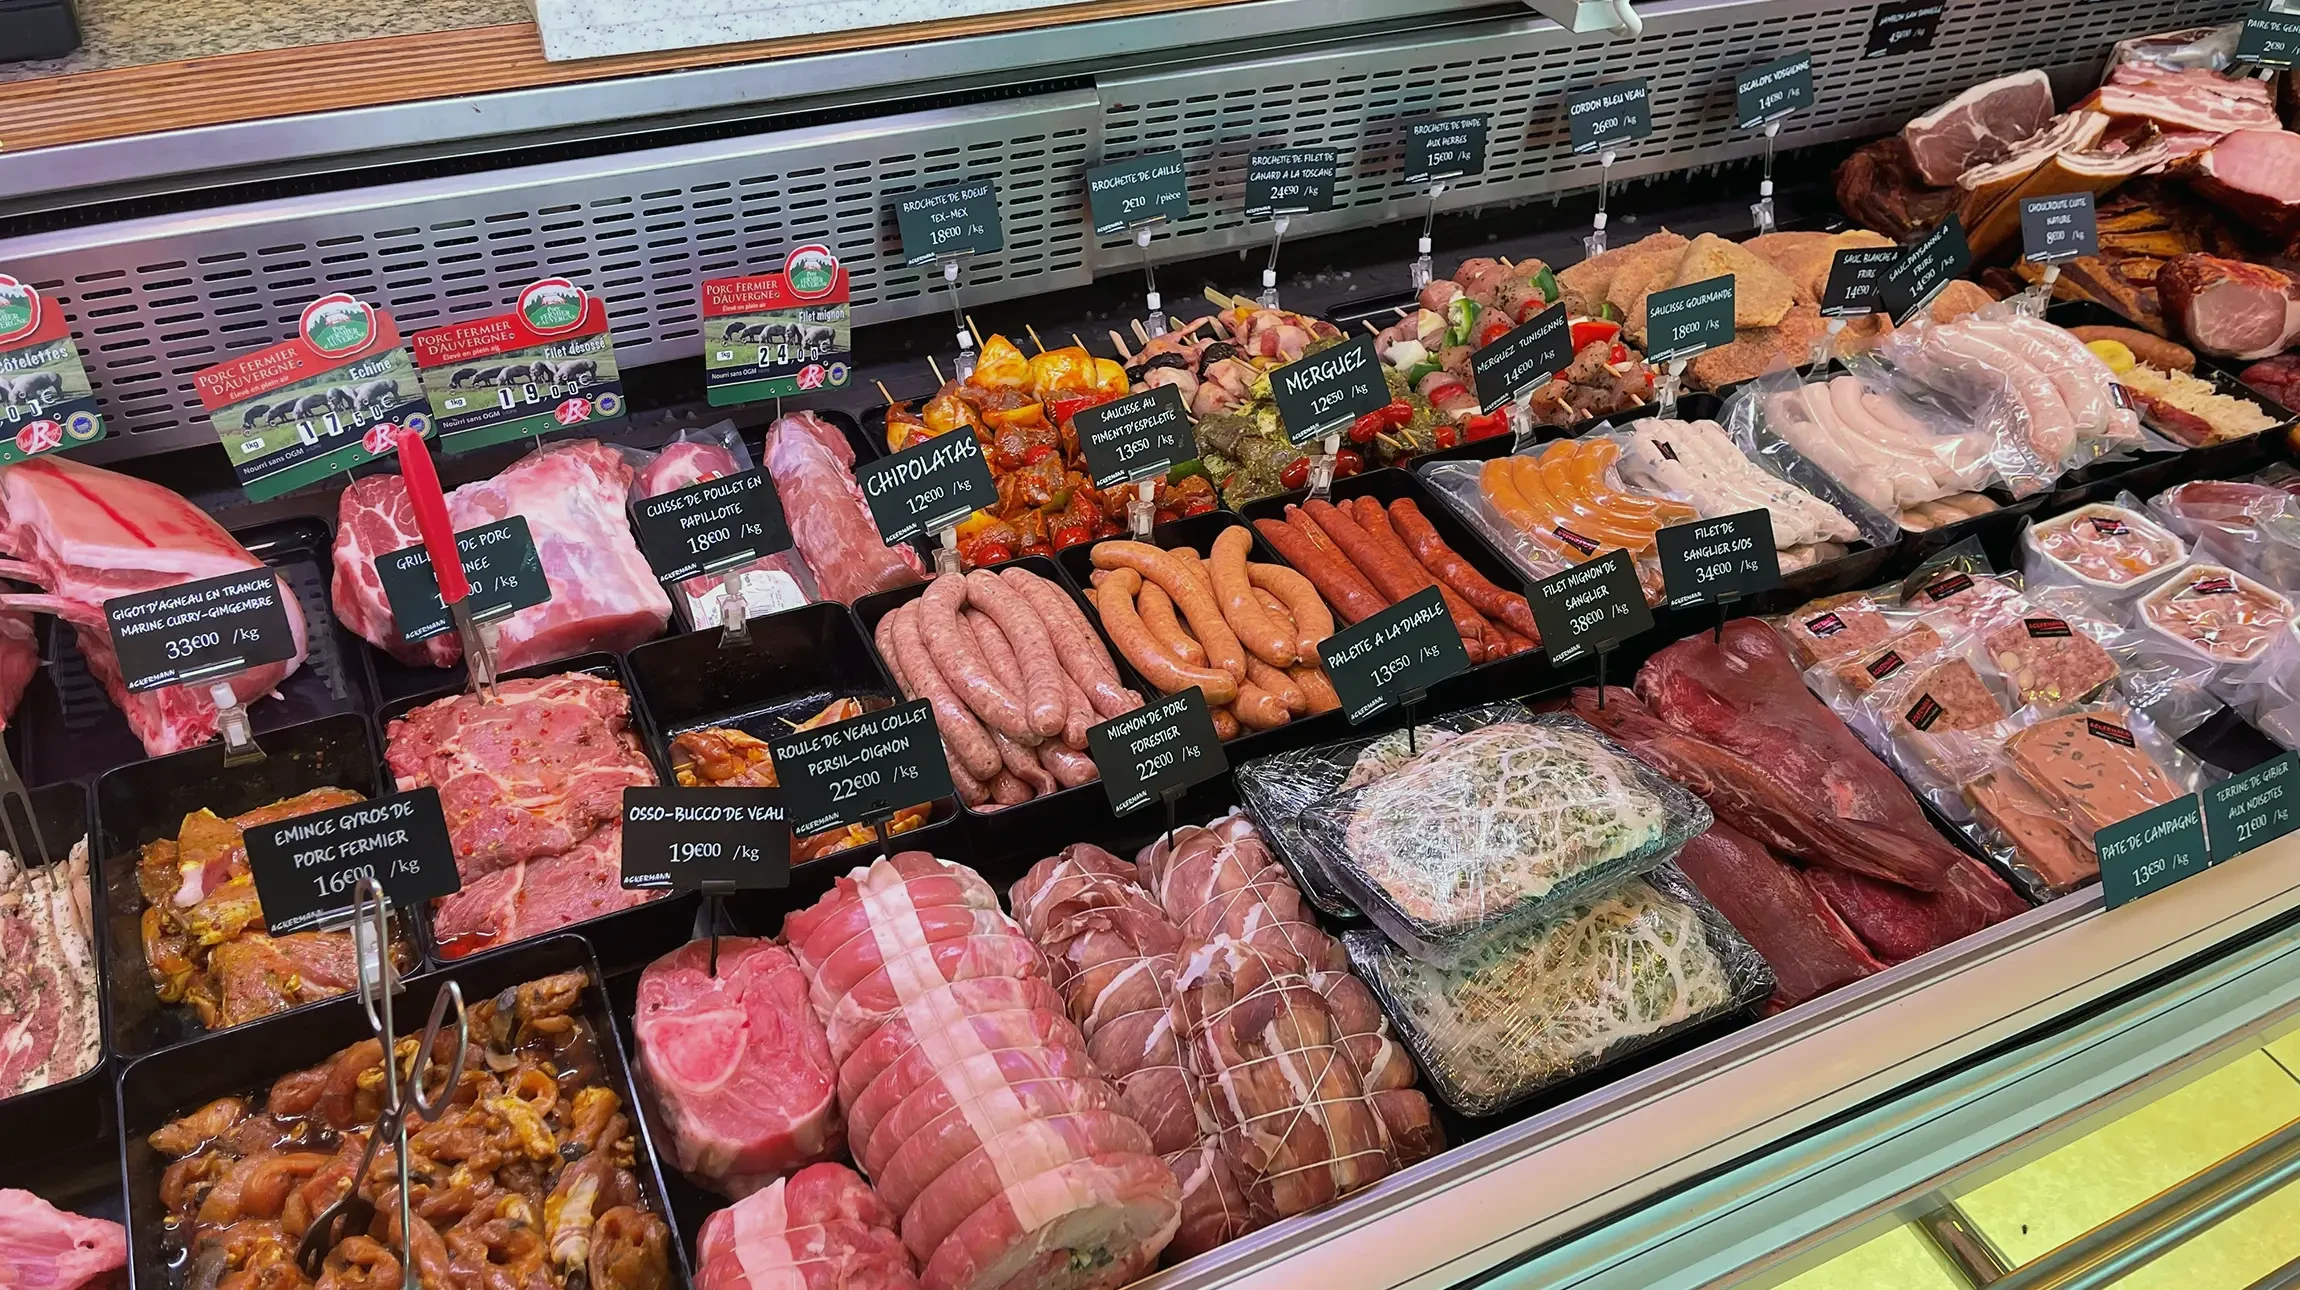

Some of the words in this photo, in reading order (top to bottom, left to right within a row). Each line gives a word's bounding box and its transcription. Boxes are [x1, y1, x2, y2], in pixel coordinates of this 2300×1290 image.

[2247, 19, 2269, 30] PAIRE
[2271, 22, 2281, 31] DE
[1571, 99, 1601, 115] CORDON
[1603, 93, 1623, 107] BLEU
[1625, 88, 1645, 100] VEAU
[1414, 122, 1449, 135] BROCHETTE
[1450, 120, 1460, 130] DE
[1461, 118, 1481, 129] DINDE
[1592, 117, 1618, 135] 26€00
[1623, 116, 1636, 126] /kg
[1252, 155, 1291, 166] BROCHETTE
[1292, 154, 1303, 164] DE
[1304, 153, 1323, 163] FILET
[1324, 152, 1334, 161] DE
[1428, 151, 1453, 166] 15€00
[1457, 151, 1471, 161] /kg
[1092, 173, 1137, 192] BROCHETTE
[1137, 170, 1150, 181] DE
[1151, 163, 1182, 179] CAILLE
[1250, 171, 1281, 181] CANARD
[1282, 171, 1288, 179] A
[1290, 169, 1300, 178] LA
[1302, 168, 1333, 178] TOSCANE
[903, 194, 947, 213] BROCHETTE
[947, 192, 960, 203] DE
[961, 185, 989, 201] BOEUF
[1122, 196, 1146, 213] 2€10
[1270, 185, 1299, 199] 24€90
[1303, 185, 1319, 196] /kg
[931, 207, 968, 223] TEX-MEX
[930, 225, 961, 245] 18€00
[967, 224, 984, 236] /kg
[1909, 268, 1936, 298] 14€90
[1940, 255, 1955, 271] /kg
[1913, 254, 1934, 276] FRIRE
[707, 285, 733, 295] PORC
[736, 280, 778, 291] FERMIER
[1845, 285, 1869, 299] 14€90
[799, 310, 815, 322] Filet
[816, 309, 845, 322] mignon
[1650, 300, 1684, 318] SAUCISSE
[1686, 288, 1732, 309] GOURMANDE
[418, 332, 452, 347] PORC
[456, 321, 511, 339] FERMIER
[1672, 321, 1700, 340] 18€00
[1705, 319, 1720, 331] /kg
[442, 351, 461, 361] Élevé
[472, 347, 490, 357] plein
[545, 345, 567, 359] Filet
[569, 337, 606, 355] désossé
[1477, 345, 1515, 374] MERGUEZ
[1519, 316, 1564, 348] TUNISIENNE
[198, 367, 236, 388] PORC
[240, 347, 298, 372] FERMIER
[349, 358, 392, 380] Echine
[1285, 347, 1366, 395] MERGUEZ
[1504, 359, 1533, 385] 14€00
[1540, 350, 1555, 364] /kg
[229, 388, 249, 400] Élevé
[250, 386, 260, 394] en
[261, 378, 280, 391] plein
[281, 375, 290, 385] air
[1311, 390, 1344, 415] 12€50
[1351, 383, 1368, 398] /kg
[443, 418, 466, 429] Nourri
[466, 415, 482, 424] sans
[483, 410, 500, 420] OGM
[1101, 401, 1141, 422] SAUCISSE
[1142, 397, 1156, 409] AU
[244, 439, 260, 450] 1kg
[1092, 425, 1124, 444] PIMENT
[1116, 438, 1150, 461] 13€50
[1157, 434, 1174, 448] /kg
[243, 461, 268, 475] Nourri
[268, 454, 285, 467] sans
[285, 447, 304, 460] OGM
[867, 436, 977, 496] CHIPOLATAS
[647, 498, 684, 517] CUISSE
[684, 493, 702, 507] DE
[703, 480, 744, 501] POULET
[746, 475, 762, 489] EN
[906, 486, 944, 514] 12€00
[953, 480, 972, 495] /kg
[680, 502, 743, 529] PAPILLOTTE
[457, 539, 478, 552] DE
[479, 527, 512, 546] PORC
[687, 527, 730, 554] 18€00
[741, 522, 762, 539] /kg
[1694, 524, 1721, 540] FILET
[1720, 521, 1735, 535] DE
[1683, 541, 1731, 562] SANGLIER
[1731, 537, 1753, 552] S/OS
[494, 574, 518, 592] /kg
[1542, 579, 1567, 598] FILET
[1568, 565, 1603, 588] MIGNON
[1602, 560, 1617, 574] DE
[1695, 561, 1732, 583] 34€00
[1740, 559, 1758, 573] /kg
[112, 605, 147, 621] GIGOT
[146, 593, 203, 615] D'AGNEAU
[206, 589, 220, 600] EN
[222, 578, 273, 598] TRANCHE
[1565, 585, 1610, 611] SANGLIER
[120, 618, 164, 637] MARINE
[166, 595, 274, 629] CURRY-GIMGEMBRE
[1570, 608, 1604, 636] 38€00
[1611, 603, 1629, 619] /kg
[165, 631, 219, 660] 33€00
[232, 627, 260, 644] /kg
[1327, 638, 1373, 669] PALETTE
[1374, 632, 1384, 647] A
[1385, 624, 1401, 641] LA
[1400, 602, 1444, 633] DIABLE
[128, 669, 176, 689] ACKERMANN
[1371, 654, 1411, 688] 13€50
[1419, 644, 1440, 664] /kg
[1106, 716, 1147, 741] MIGNON
[1146, 709, 1163, 725] DE
[1162, 698, 1188, 718] PORC
[777, 738, 822, 761] ROULE
[820, 732, 842, 748] DE
[842, 722, 879, 741] VEAU
[881, 707, 928, 732] COLLET
[1130, 725, 1181, 756] FORESTIER
[808, 736, 910, 777] PERSIL-OIGNON
[1135, 751, 1174, 782] 22€00
[1182, 745, 1201, 762] /kg
[829, 770, 881, 802] 22€00
[893, 764, 919, 783] /kg
[2216, 781, 2251, 802] TERRINE
[2249, 773, 2262, 789] DE
[2262, 761, 2289, 782] GIBIER
[629, 806, 722, 822] OSSO-BUCCO
[722, 806, 744, 821] DE
[747, 806, 784, 822] VEAU
[2228, 804, 2246, 820] AUX
[2247, 784, 2284, 810] NOISETTES
[275, 818, 336, 846] EMINCE
[339, 807, 390, 831] GYROS
[388, 800, 414, 818] DE
[795, 811, 840, 835] ACKERMANN
[2101, 838, 2128, 861] PATE
[2126, 832, 2143, 849] DE
[2144, 810, 2199, 844] CAMPAGNE
[2236, 813, 2267, 842] 21€00
[2272, 808, 2289, 825] /kg
[294, 846, 336, 869] PORC
[338, 829, 409, 858] FERMIER
[669, 842, 722, 863] 19€00
[732, 845, 760, 862] /kg
[313, 863, 375, 898] 16€00
[390, 858, 421, 879] /kg
[623, 872, 672, 884] ACKERMANN
[2132, 858, 2166, 887] 13€50
[2172, 852, 2189, 870] /kg
